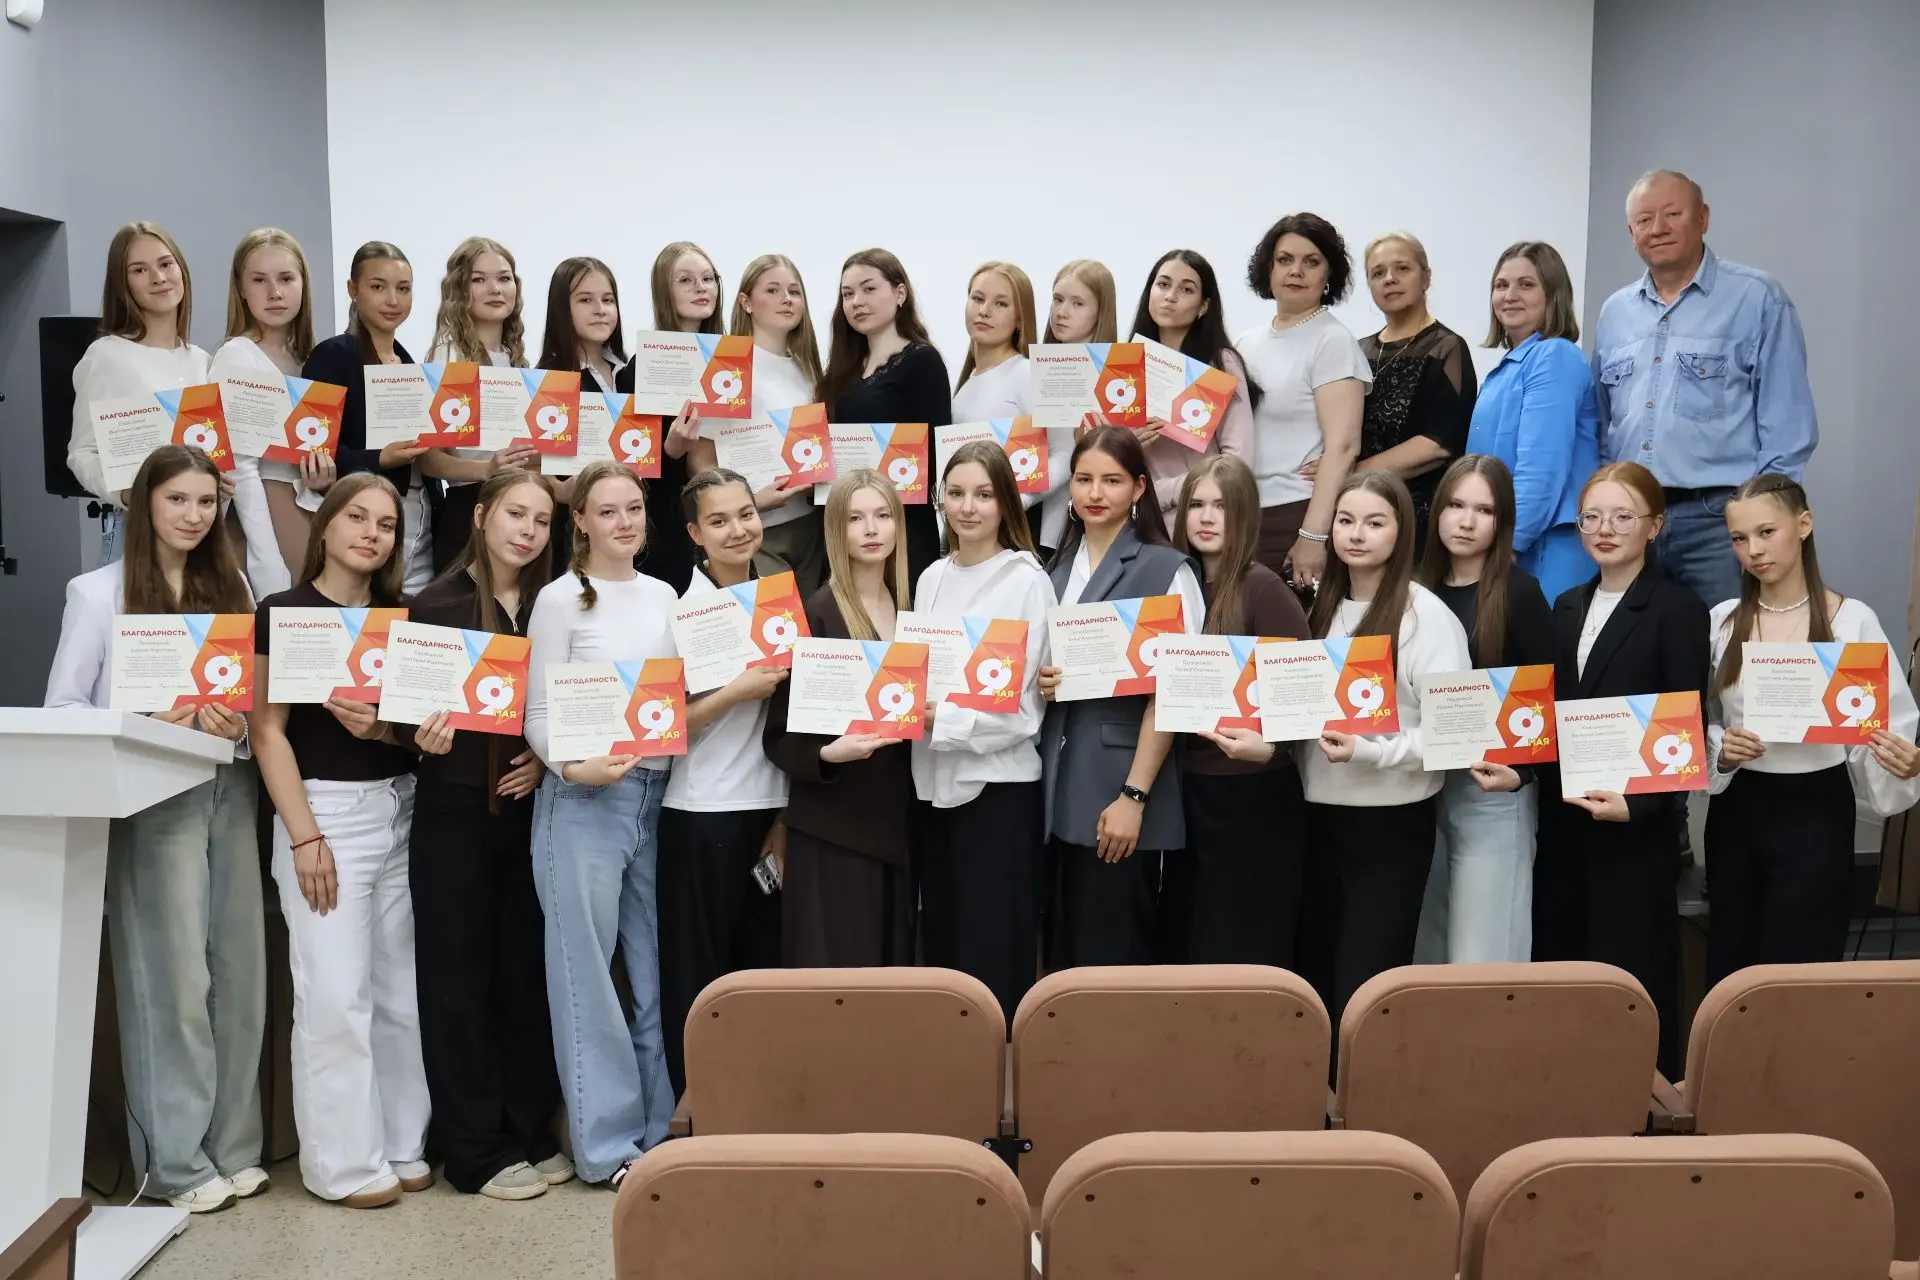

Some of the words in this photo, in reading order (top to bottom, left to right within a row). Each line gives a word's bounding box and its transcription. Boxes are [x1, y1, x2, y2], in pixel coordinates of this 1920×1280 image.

[643, 343, 697, 352] БЛАГОДАРНОСТЬ
[1146, 352, 1183, 373] ГОДАРНОСТЬ
[227, 378, 286, 394] БЛАГОДАРНОСТЬ
[711, 370, 743, 404] 9
[1105, 378, 1136, 414] 9
[1121, 406, 1141, 414] МАЯ
[99, 406, 161, 421] БЛАГОДАРНОСТЬ
[439, 397, 471, 433] 9
[456, 425, 474, 433] МАЯ
[535, 405, 569, 440] 9
[1175, 398, 1212, 432] 9
[183, 423, 218, 453] 9
[295, 416, 329, 452] 9
[551, 433, 572, 442] МАЯ
[720, 424, 772, 436] БЛАГОДАРНОСТЬ
[942, 432, 993, 444] БЛАГОДАРНОСТЬ
[619, 429, 652, 463] 9
[792, 439, 823, 473] 9
[635, 456, 656, 464] МАЯ
[1009, 448, 1039, 481] 9
[1025, 471, 1043, 481] МАЯ
[887, 457, 919, 491] 9
[676, 601, 737, 621] БЛАГОДАРНОСТЬ
[903, 626, 964, 636] БЛАГОДАРНОСТЬ
[1056, 617, 1118, 627] БЛАГОДАРНОСТЬ
[397, 637, 463, 651] БЛАГОДАРНОСТЬ
[762, 615, 798, 657] 9
[801, 652, 863, 661] БЛАГОДАРНОСТЬ
[1165, 649, 1230, 657] БЛАГОДАРНОСТЬ
[1264, 655, 1327, 665] БЛАГОДАРНОСТЬ
[204, 655, 242, 695] 9
[223, 687, 247, 695] МАЯ
[554, 676, 618, 685] БЛАГОДАРНОСТЬ
[976, 658, 1012, 696] 9
[475, 675, 514, 716] 9
[991, 689, 1015, 698] МАЯ
[1347, 678, 1385, 719] 9
[1368, 708, 1391, 717] МАЯ
[1429, 684, 1491, 694] БЛАГОДАРНОСТЬ
[878, 682, 915, 722] 9
[1836, 685, 1877, 727] 9
[492, 709, 517, 719] МАЯ
[637, 699, 675, 740] 9
[656, 730, 680, 739] МАЯ
[896, 713, 918, 723] МАЯ
[1564, 712, 1631, 722] БЛАГОДАРНОСТЬ
[1856, 719, 1881, 728] МАЯ
[1508, 706, 1545, 748] 9
[1528, 737, 1550, 746] МАЯ
[1652, 734, 1693, 775] 9
[1675, 765, 1700, 774] МАЯ
